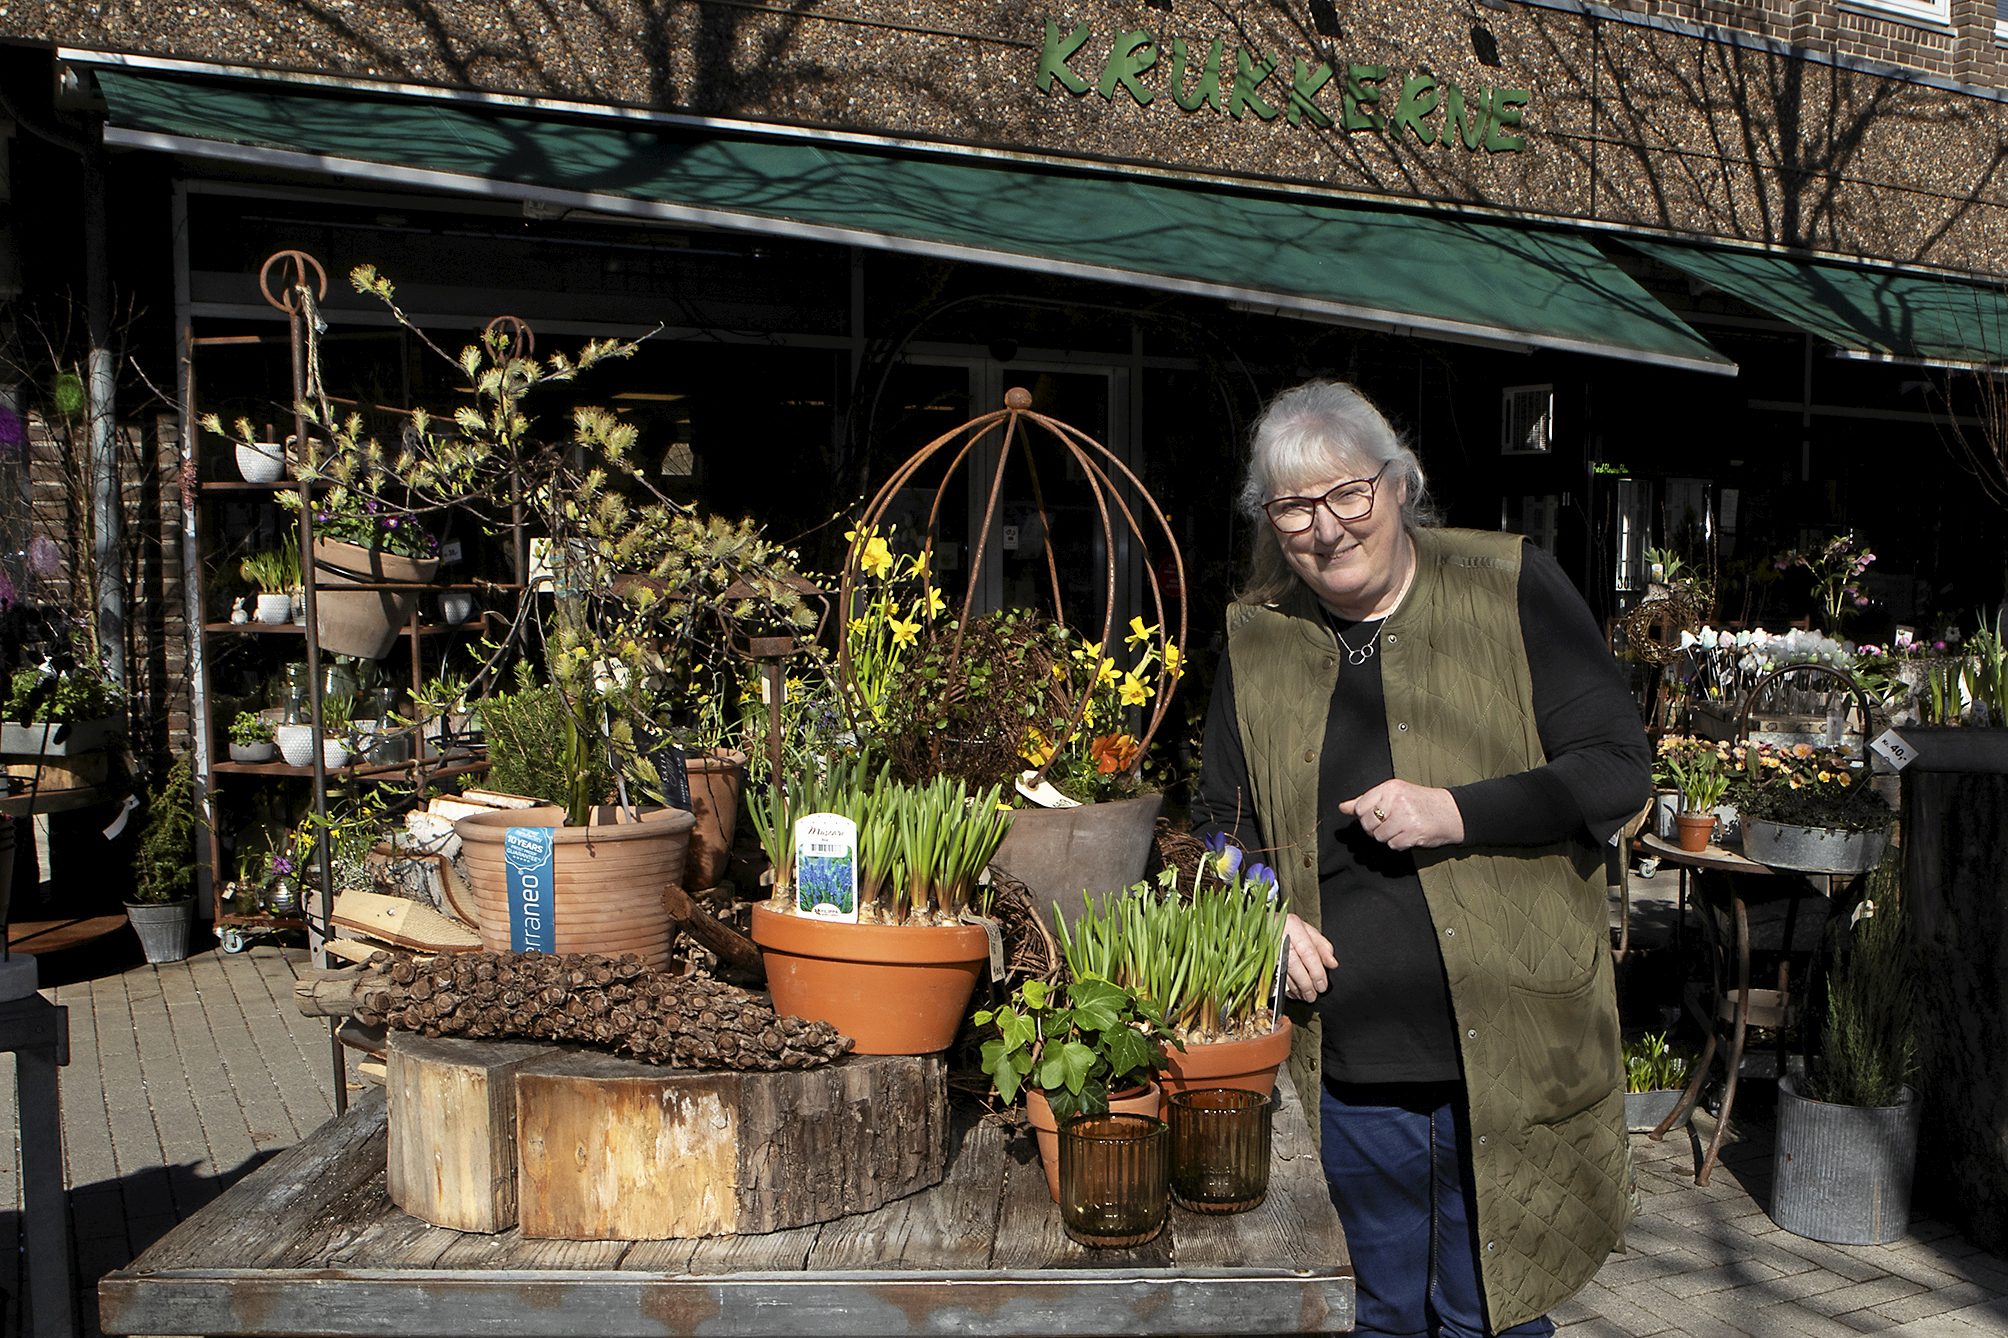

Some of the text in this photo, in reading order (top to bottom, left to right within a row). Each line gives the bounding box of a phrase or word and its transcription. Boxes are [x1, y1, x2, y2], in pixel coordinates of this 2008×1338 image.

[1036, 18, 1529, 152] KRUKKERNE
[1890, 745, 1907, 761] 40,-
[507, 835, 517, 844] 10
[517, 838, 543, 853] YEARS
